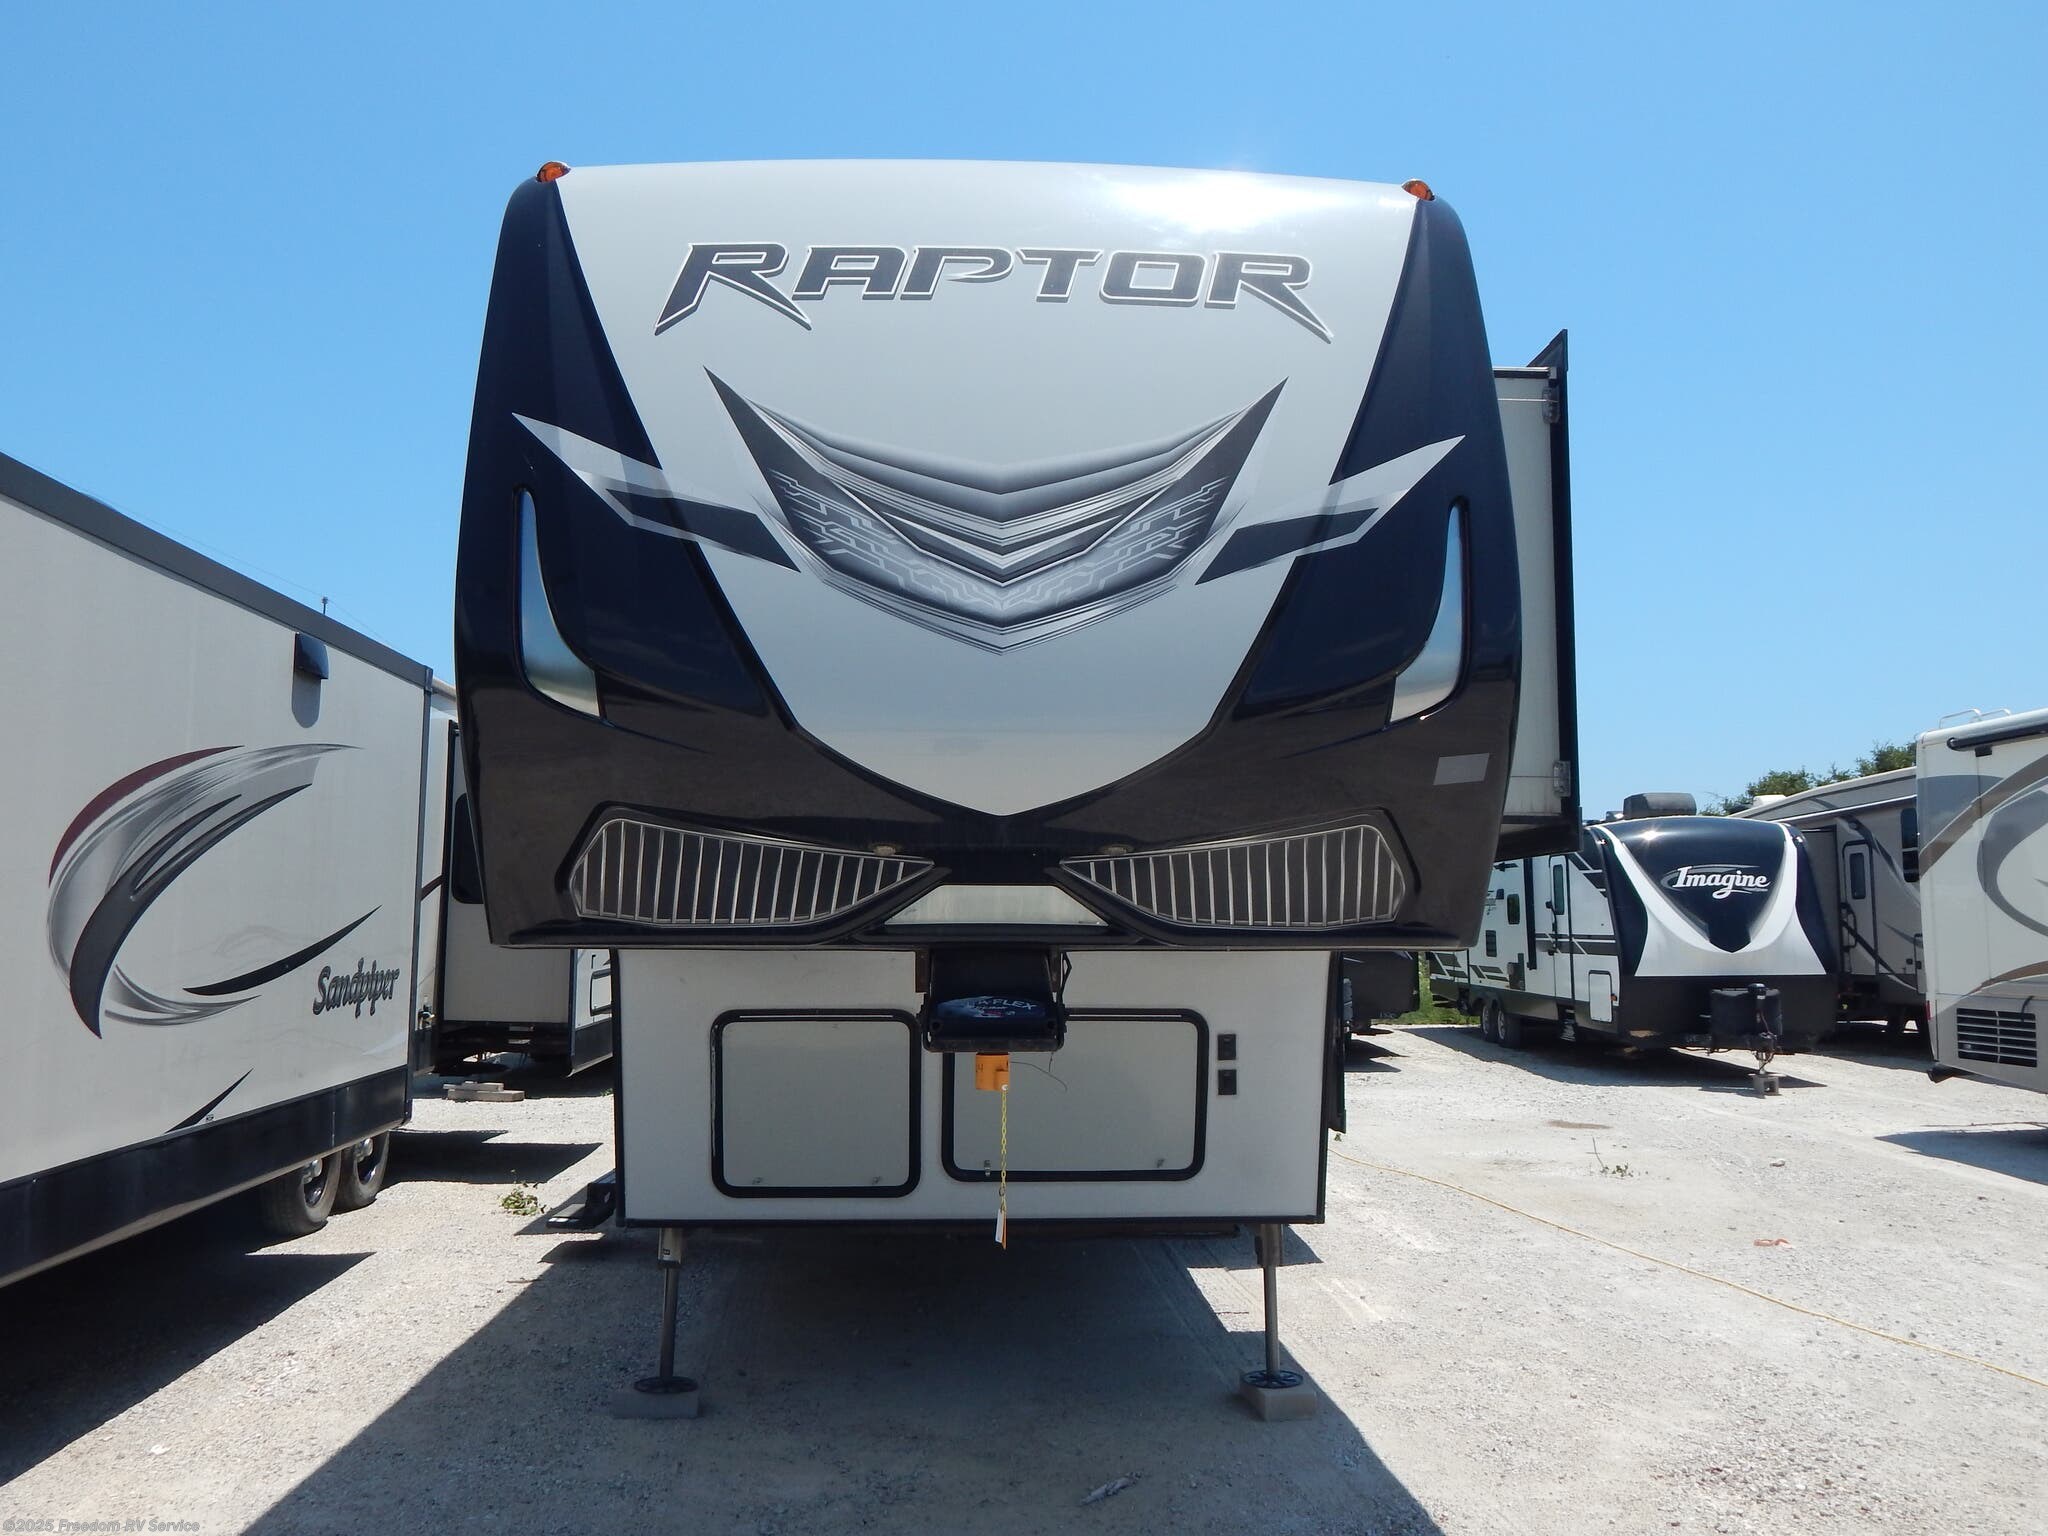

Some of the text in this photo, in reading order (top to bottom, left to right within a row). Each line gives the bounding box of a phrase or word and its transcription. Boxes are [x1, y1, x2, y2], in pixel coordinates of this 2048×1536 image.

[654, 241, 1334, 344] RAPTOR
[1672, 866, 1771, 899] Imagine
[313, 957, 401, 1019] Sandpiper
